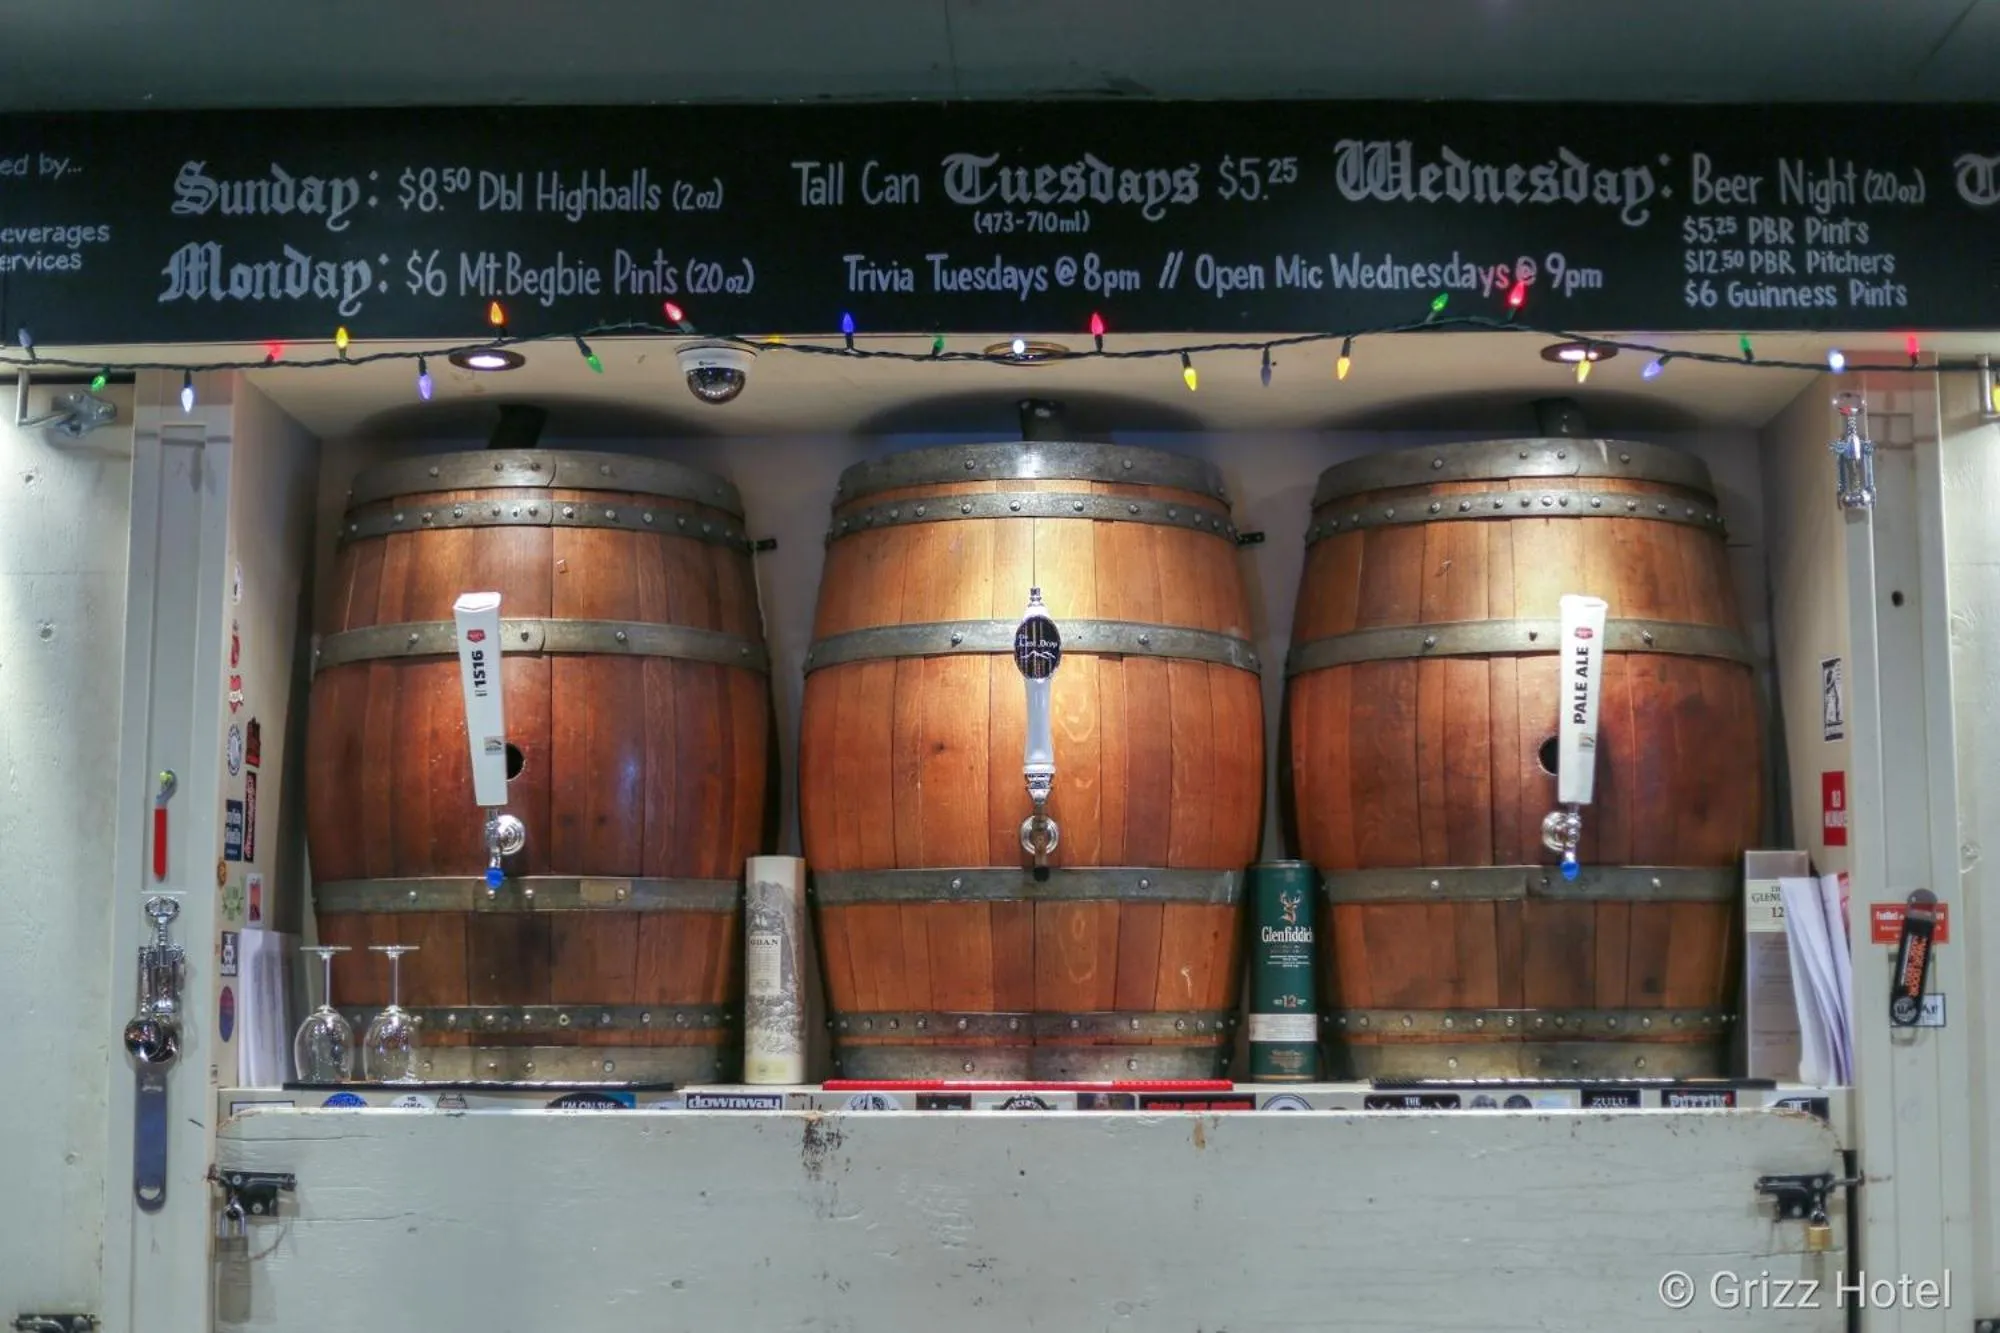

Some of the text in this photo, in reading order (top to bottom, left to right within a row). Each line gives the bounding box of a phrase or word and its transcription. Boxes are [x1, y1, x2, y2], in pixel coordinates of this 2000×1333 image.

[479, 171, 522, 211] Dbl
[537, 168, 661, 222] Highballs
[673, 178, 723, 210] (2oz)
[791, 162, 843, 205] Tall
[862, 160, 919, 205] Can
[941, 153, 1200, 221] Tuesdays
[1334, 136, 1925, 225] Wednesday: Beer Night (20oz)
[974, 210, 1089, 234] (473-710ml)
[1749, 216, 1794, 245] PBR
[1805, 216, 1869, 244] Pints
[406, 250, 446, 296] $6
[615, 248, 678, 294] Pints
[686, 258, 754, 294] (20oz)
[843, 255, 914, 292] Trivia
[926, 253, 1048, 301] Tuesdays
[1195, 254, 1265, 298] Open
[1276, 255, 1323, 289] Mic
[1330, 252, 1510, 298] Wednesdays
[1750, 250, 1796, 274] PBR
[1806, 250, 1894, 274] Pitchers
[1685, 279, 1907, 308] $6 Guinness Pints
[472, 650, 487, 688] 1516
[1576, 646, 1589, 678] ALE
[1573, 680, 1588, 725] PALE
[1771, 906, 1785, 918] 12
